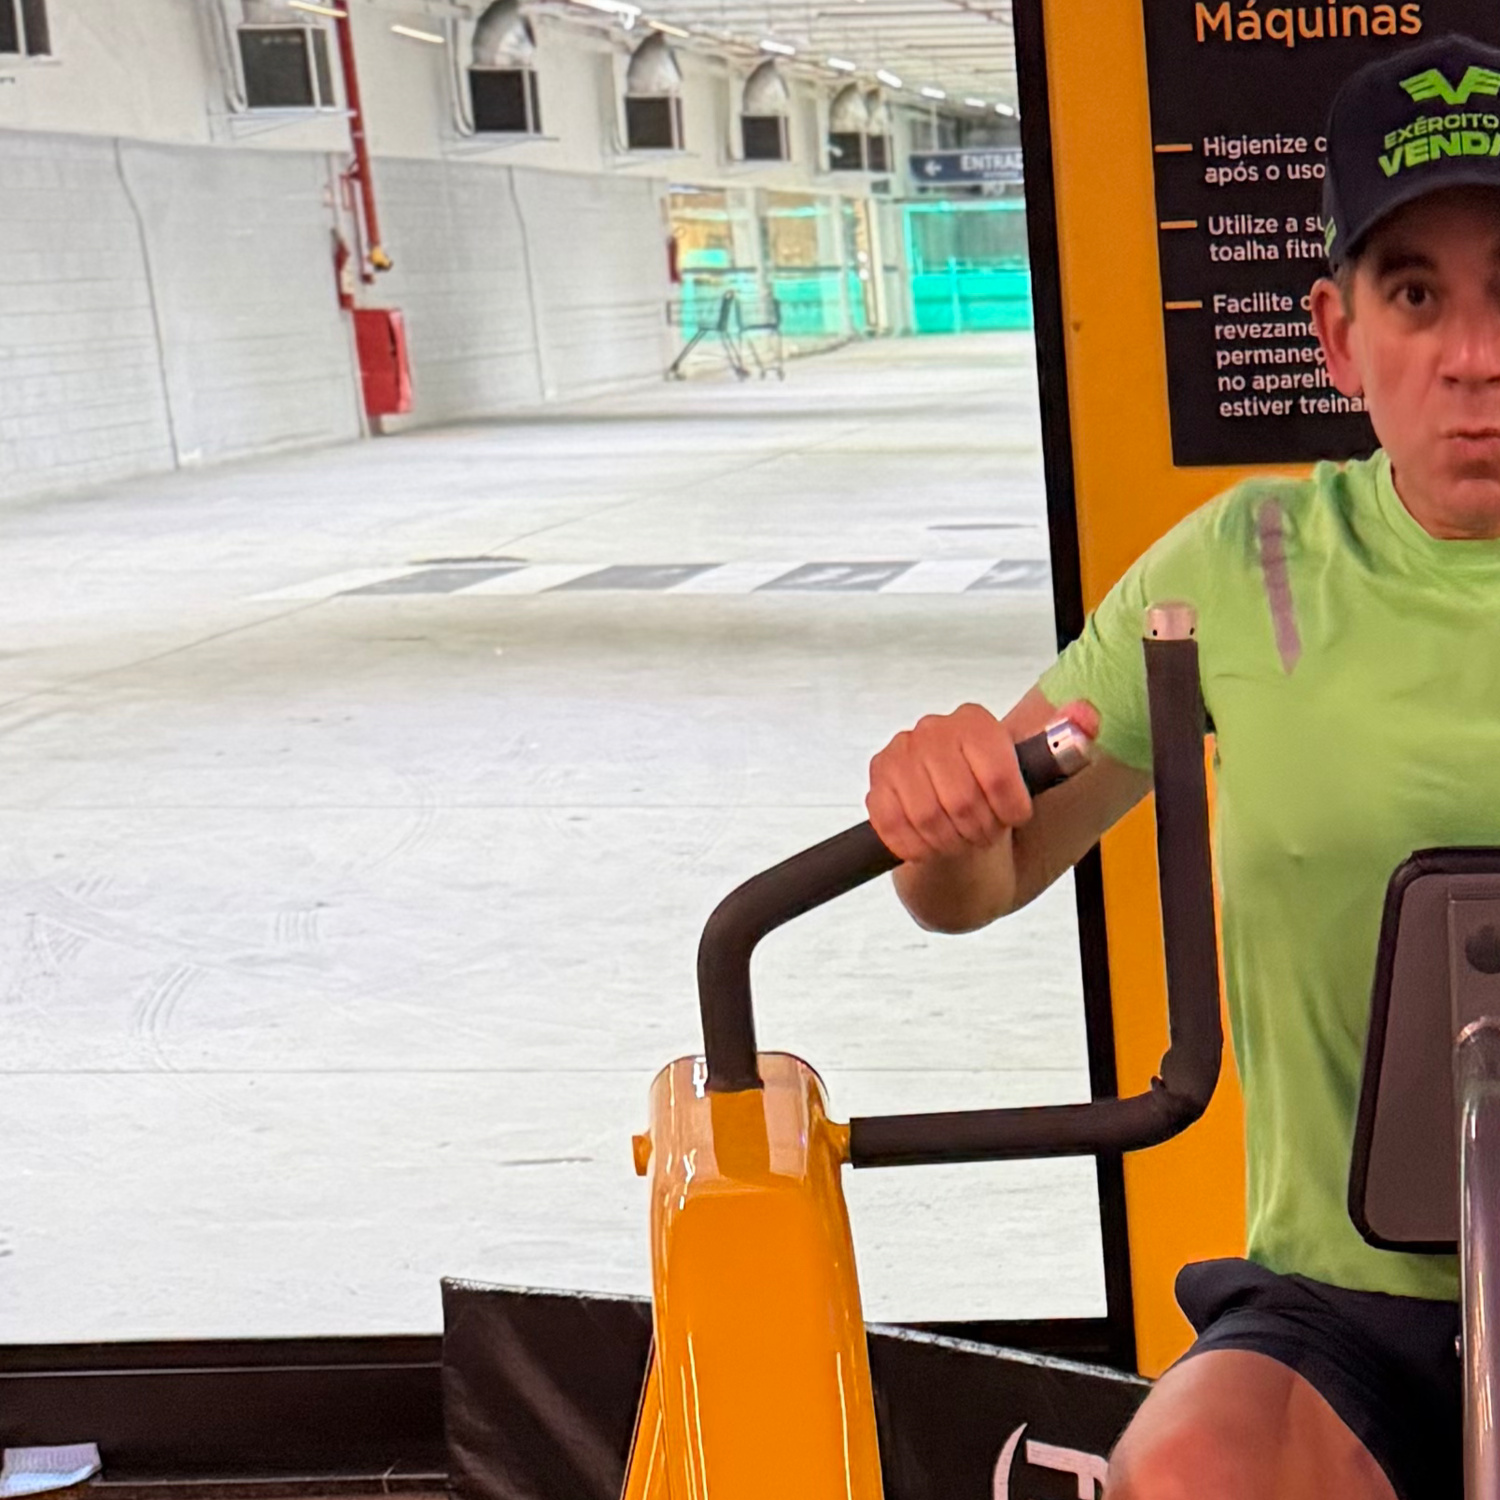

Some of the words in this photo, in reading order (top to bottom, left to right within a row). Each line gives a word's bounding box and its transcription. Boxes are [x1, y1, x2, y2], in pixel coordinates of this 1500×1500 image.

[1195, 0, 1422, 48] Máquinas
[1384, 113, 1500, 150] EXÉRCITO
[1203, 133, 1308, 160] Higienize
[1205, 160, 1259, 187] após
[1265, 165, 1280, 180] o
[1287, 163, 1326, 180] uso
[1208, 214, 1279, 235] Utilize
[1285, 217, 1298, 233] a
[1210, 240, 1279, 261] toalha
[1286, 239, 1326, 259] fitn
[1213, 292, 1293, 314] Facilite
[1218, 374, 1246, 391] no
[1219, 396, 1293, 417] estiver
